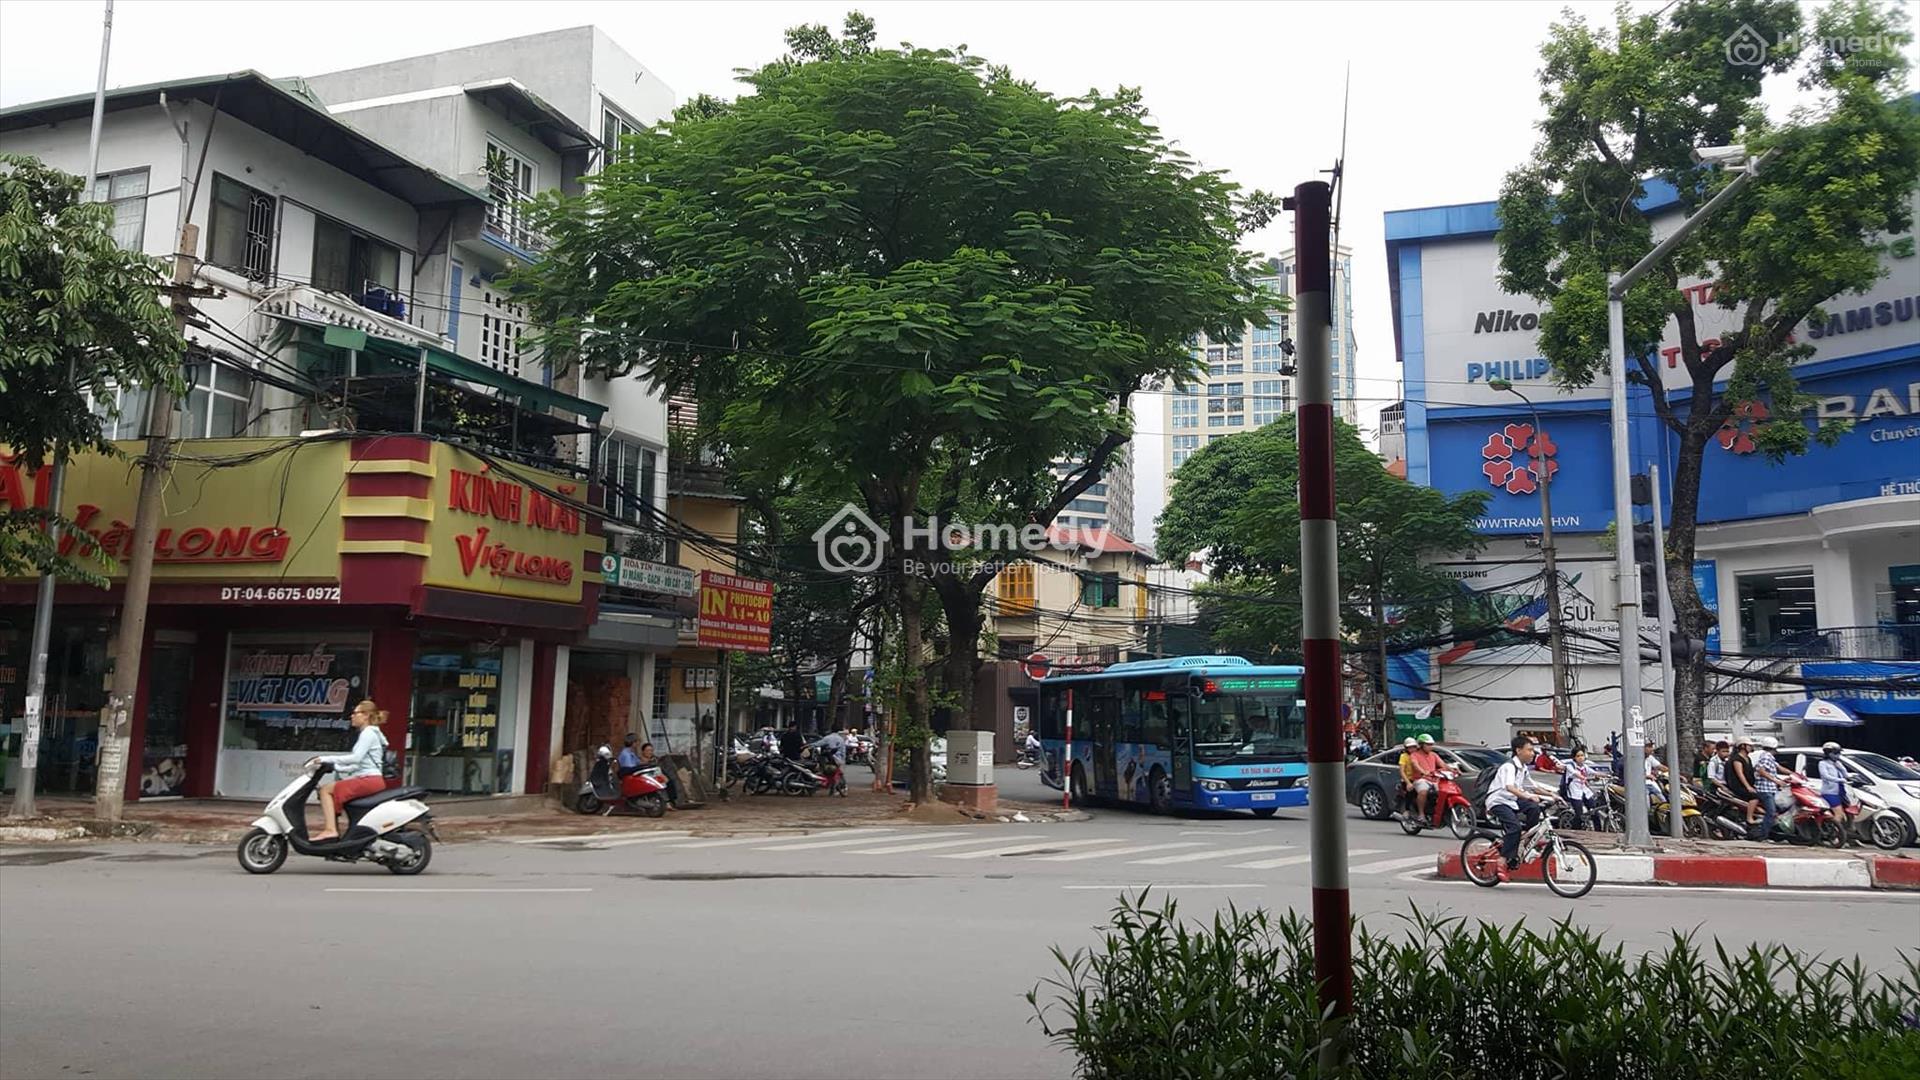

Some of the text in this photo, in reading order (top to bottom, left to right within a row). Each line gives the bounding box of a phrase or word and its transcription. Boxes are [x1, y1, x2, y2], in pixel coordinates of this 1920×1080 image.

[1474, 309, 1543, 334] Niko
[1467, 358, 1551, 383] PHILIP
[1465, 516, 1580, 530] WW.TRANAH.VN
[154, 525, 290, 563] LONG
[514, 551, 573, 586] LONG
[701, 586, 728, 616] IN
[730, 591, 770, 609] PHOTOCOPY
[283, 677, 350, 709] LONG
